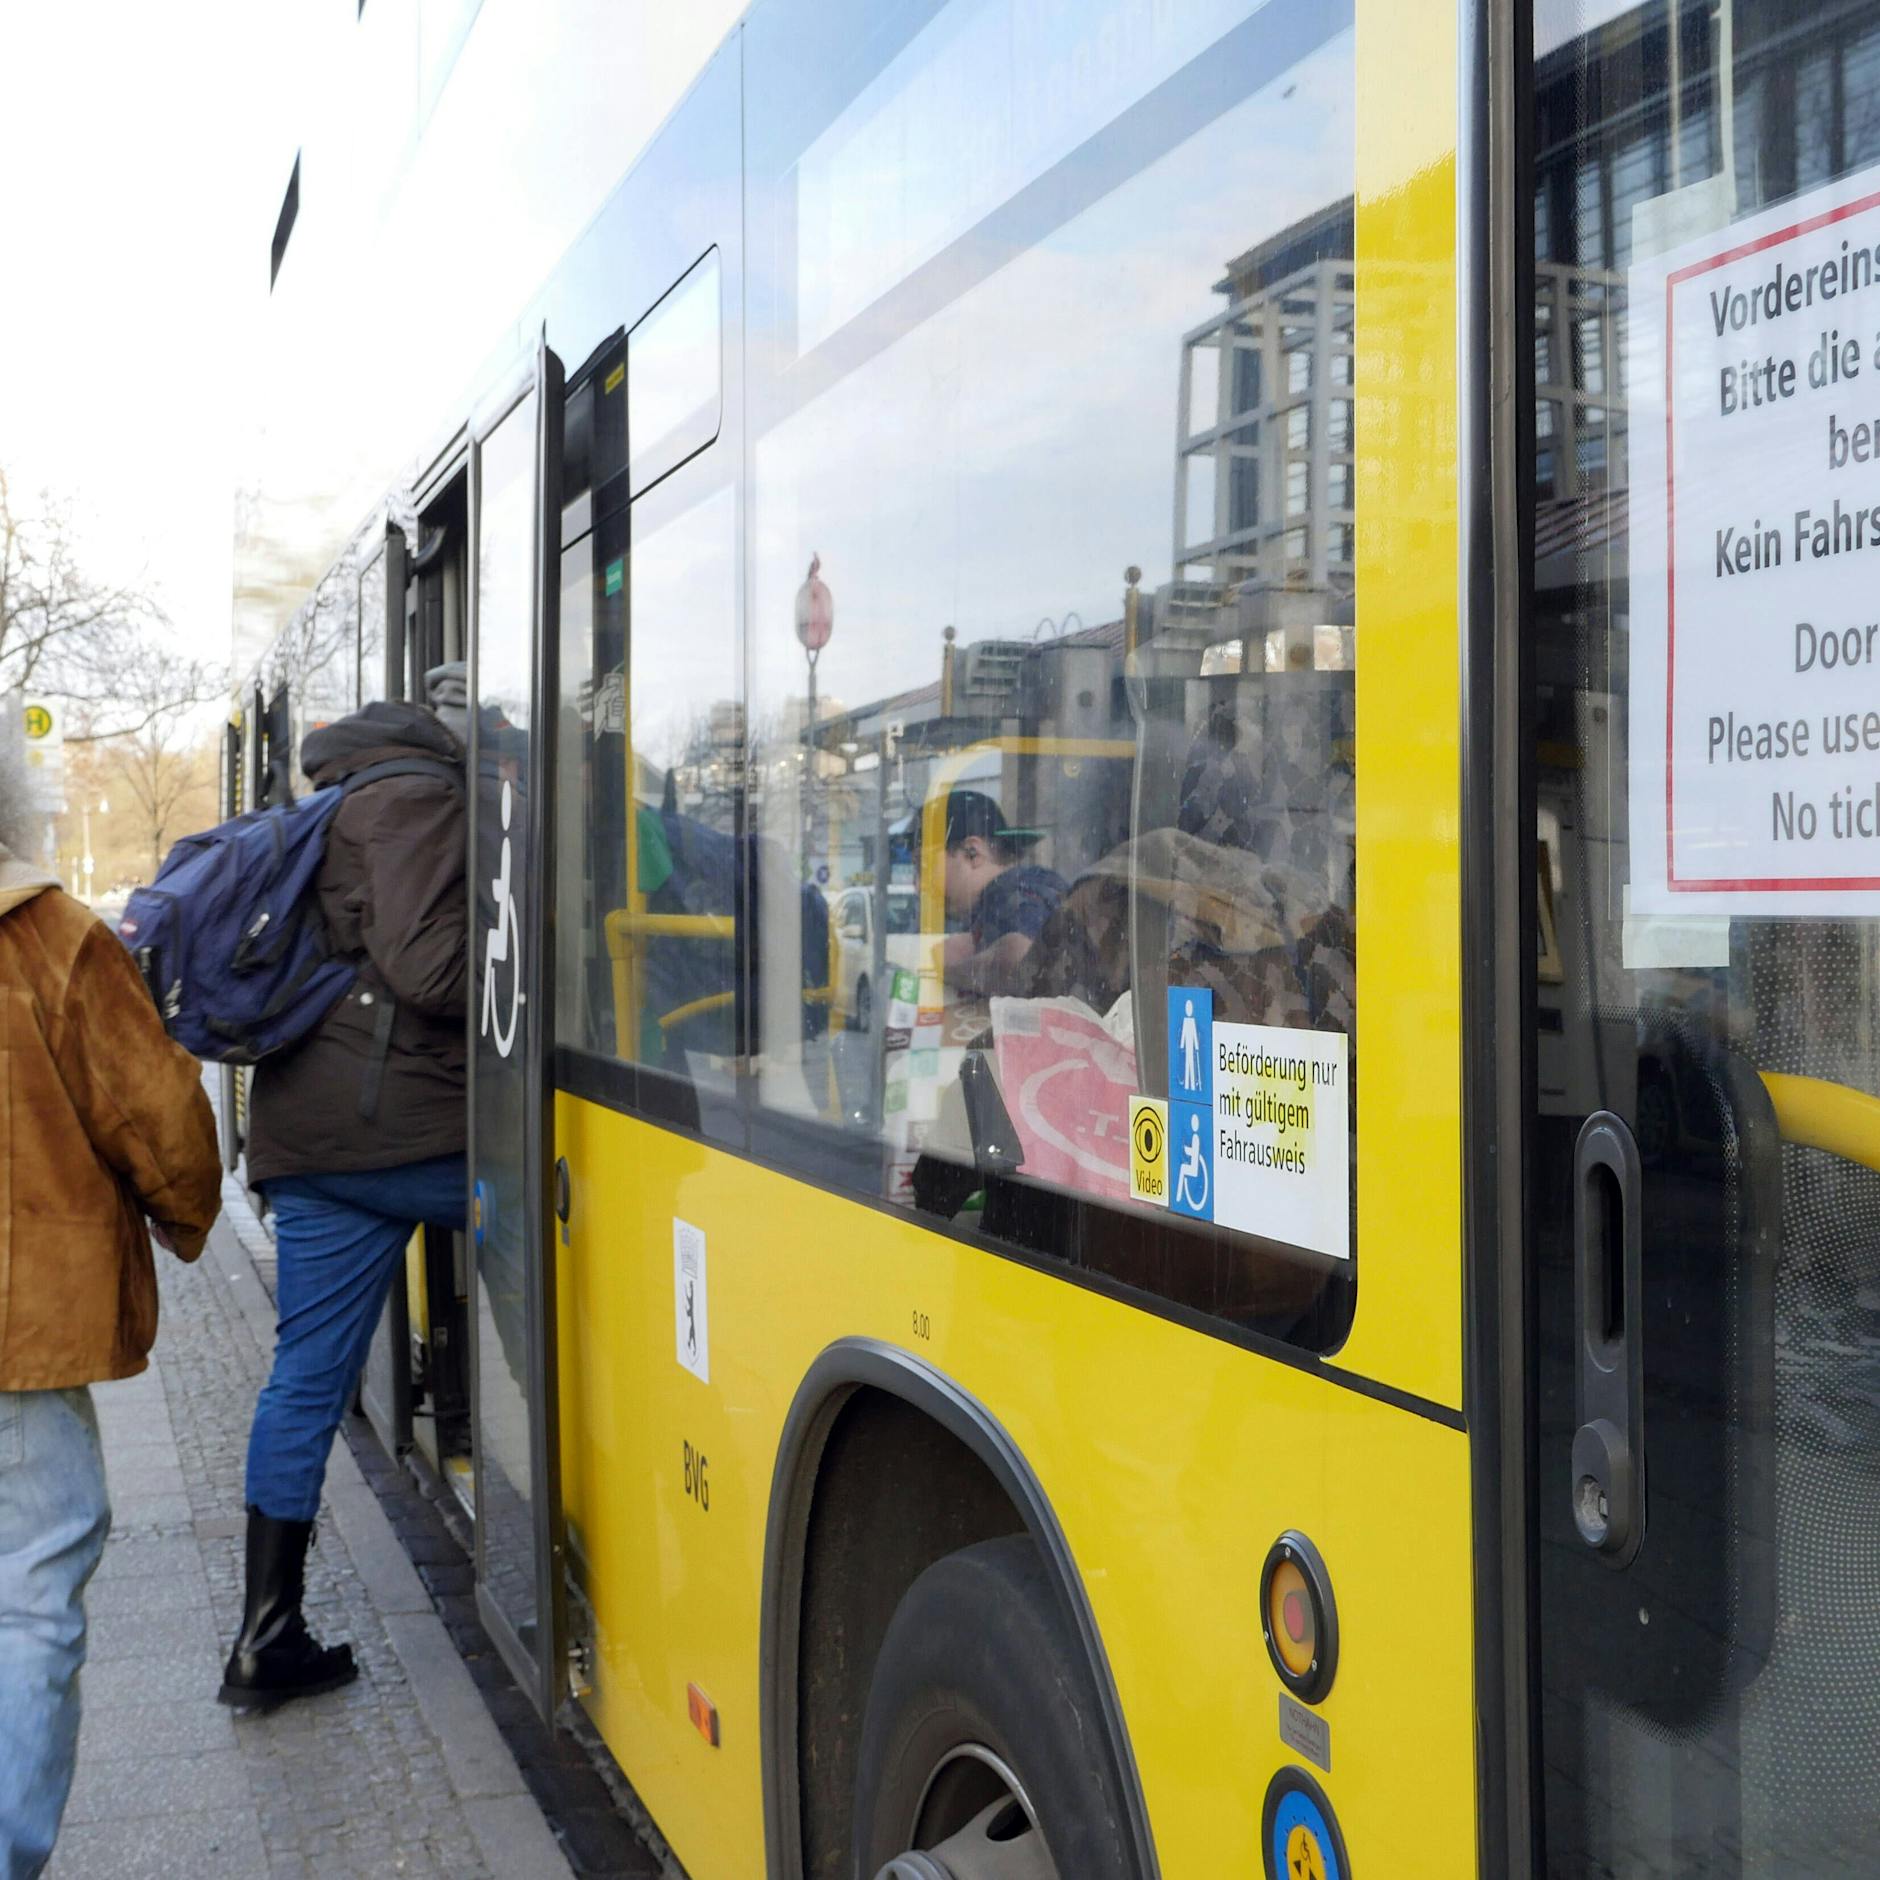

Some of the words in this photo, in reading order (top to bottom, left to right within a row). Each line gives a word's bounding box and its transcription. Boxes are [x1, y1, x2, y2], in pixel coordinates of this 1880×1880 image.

[1720, 356, 1797, 416] Bitte
[1808, 330, 1861, 389] die
[1829, 415, 1880, 470] be
[1716, 519, 1781, 578] Kein
[1795, 623, 1879, 673] Door
[1709, 711, 1810, 764] Please
[1823, 711, 1880, 754] use
[1772, 791, 1817, 841] No
[1219, 1042, 1306, 1091] Beförderung
[1312, 1059, 1337, 1086] nur
[1219, 1087, 1241, 1118] mit
[1247, 1091, 1309, 1133] gültigem
[1220, 1130, 1305, 1174] Fahrausweis
[1136, 1169, 1163, 1196] Video
[684, 1439, 709, 1512] BVG
